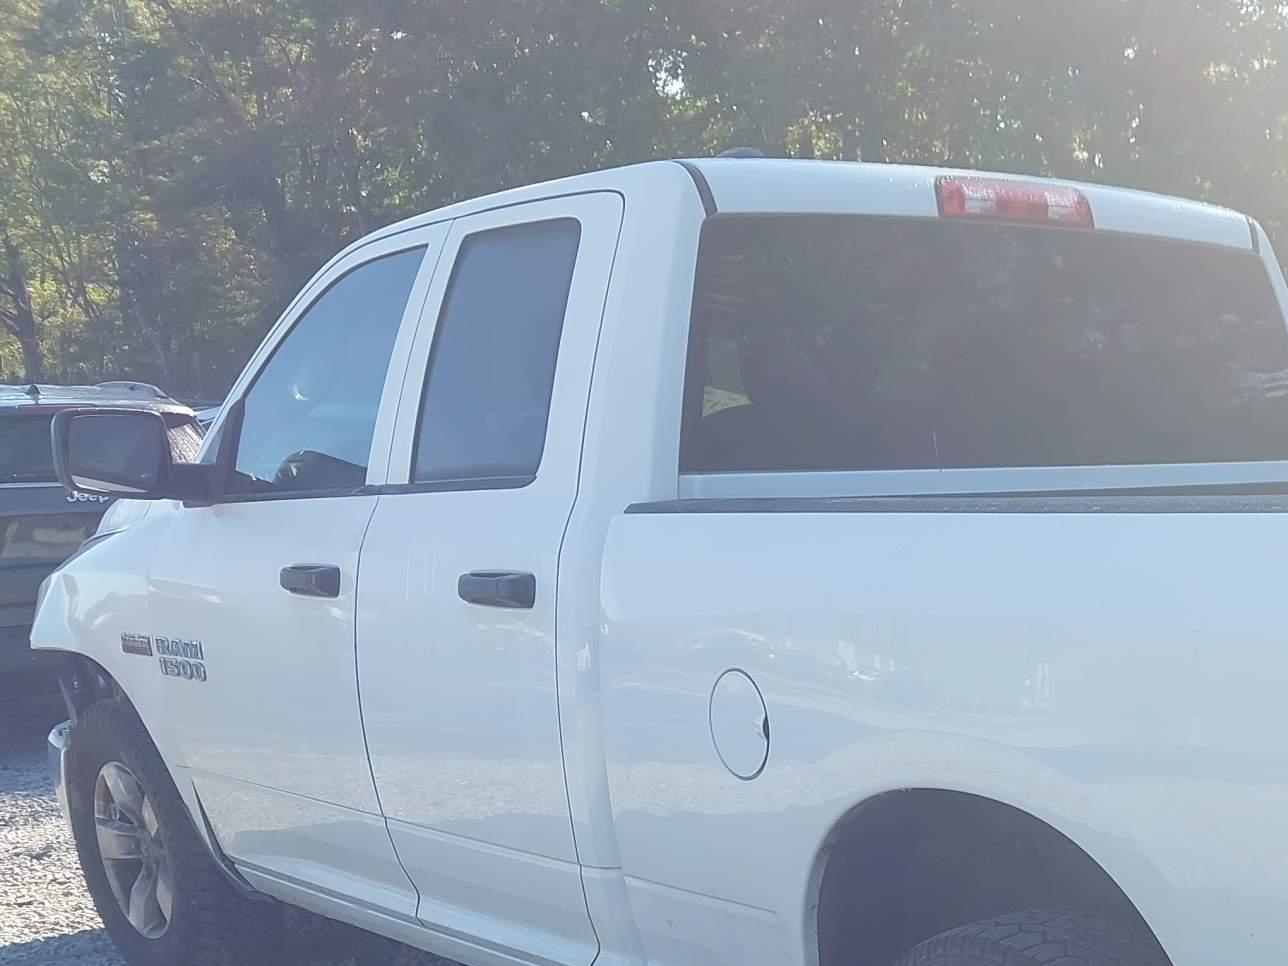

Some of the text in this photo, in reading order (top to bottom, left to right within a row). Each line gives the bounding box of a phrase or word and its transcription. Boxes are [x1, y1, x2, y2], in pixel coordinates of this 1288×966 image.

[66, 490, 110, 503] Jeep
[155, 636, 204, 661] RAM
[158, 656, 207, 682] 1500
